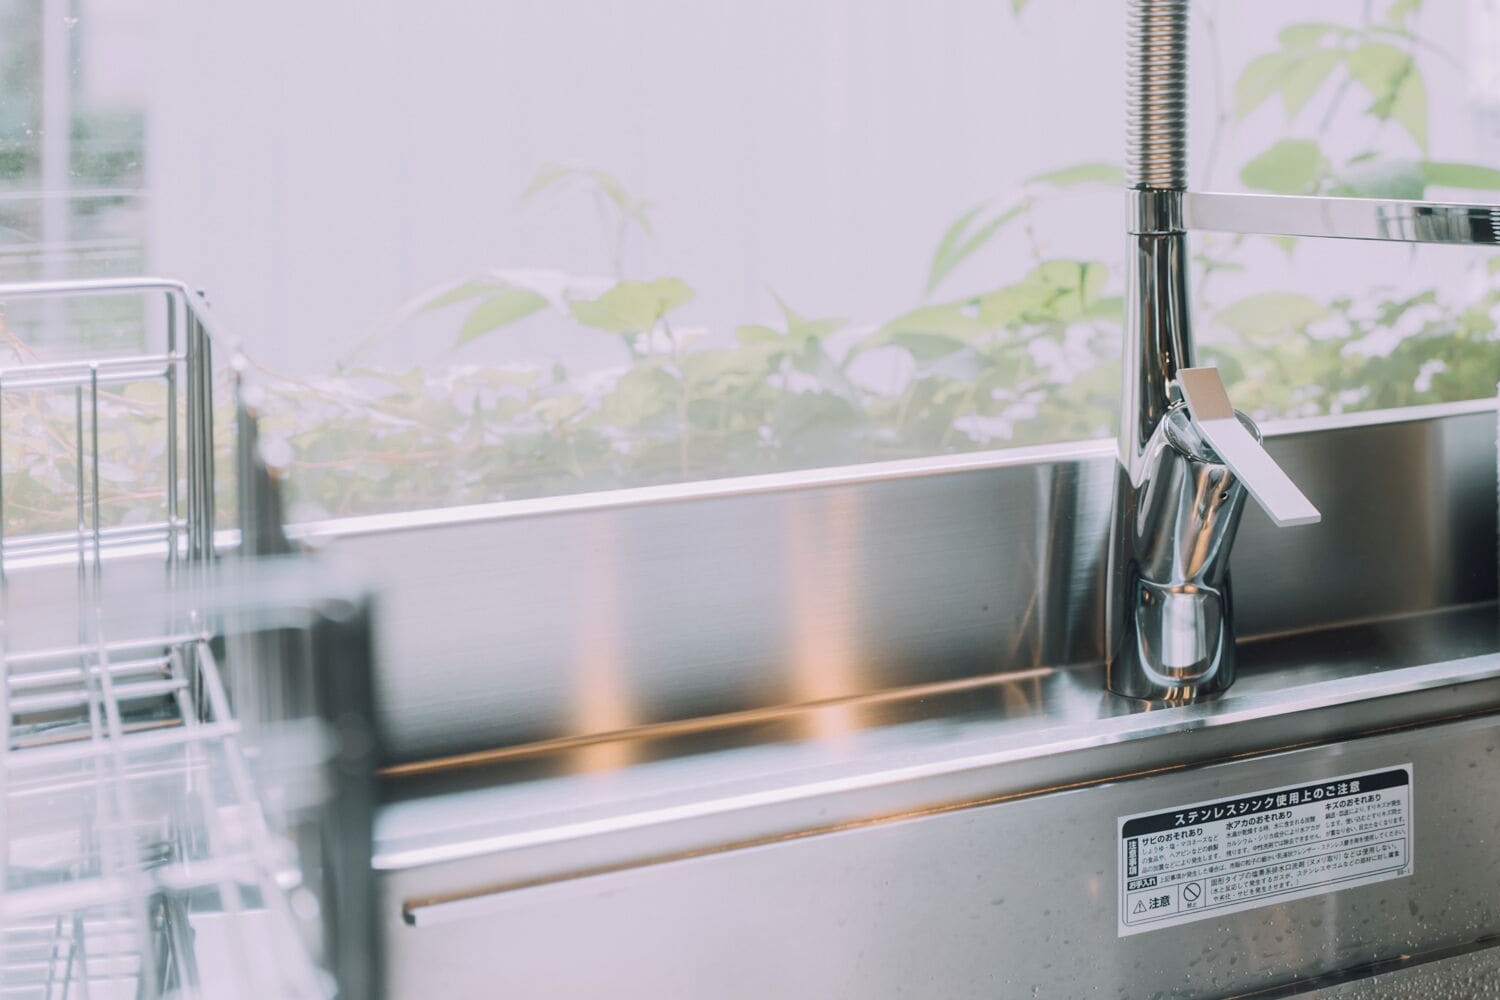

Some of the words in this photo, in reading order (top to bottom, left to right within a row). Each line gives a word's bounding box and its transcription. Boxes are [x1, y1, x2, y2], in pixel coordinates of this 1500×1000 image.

[1174, 779, 1360, 826] ステンレスシンク使用上のご注意
[1324, 792, 1381, 811] キズのおそれあり
[1225, 809, 1292, 831] 水アカのおそれあり
[1141, 826, 1203, 847] サビのおそれあり
[1148, 893, 1170, 910] 注意
